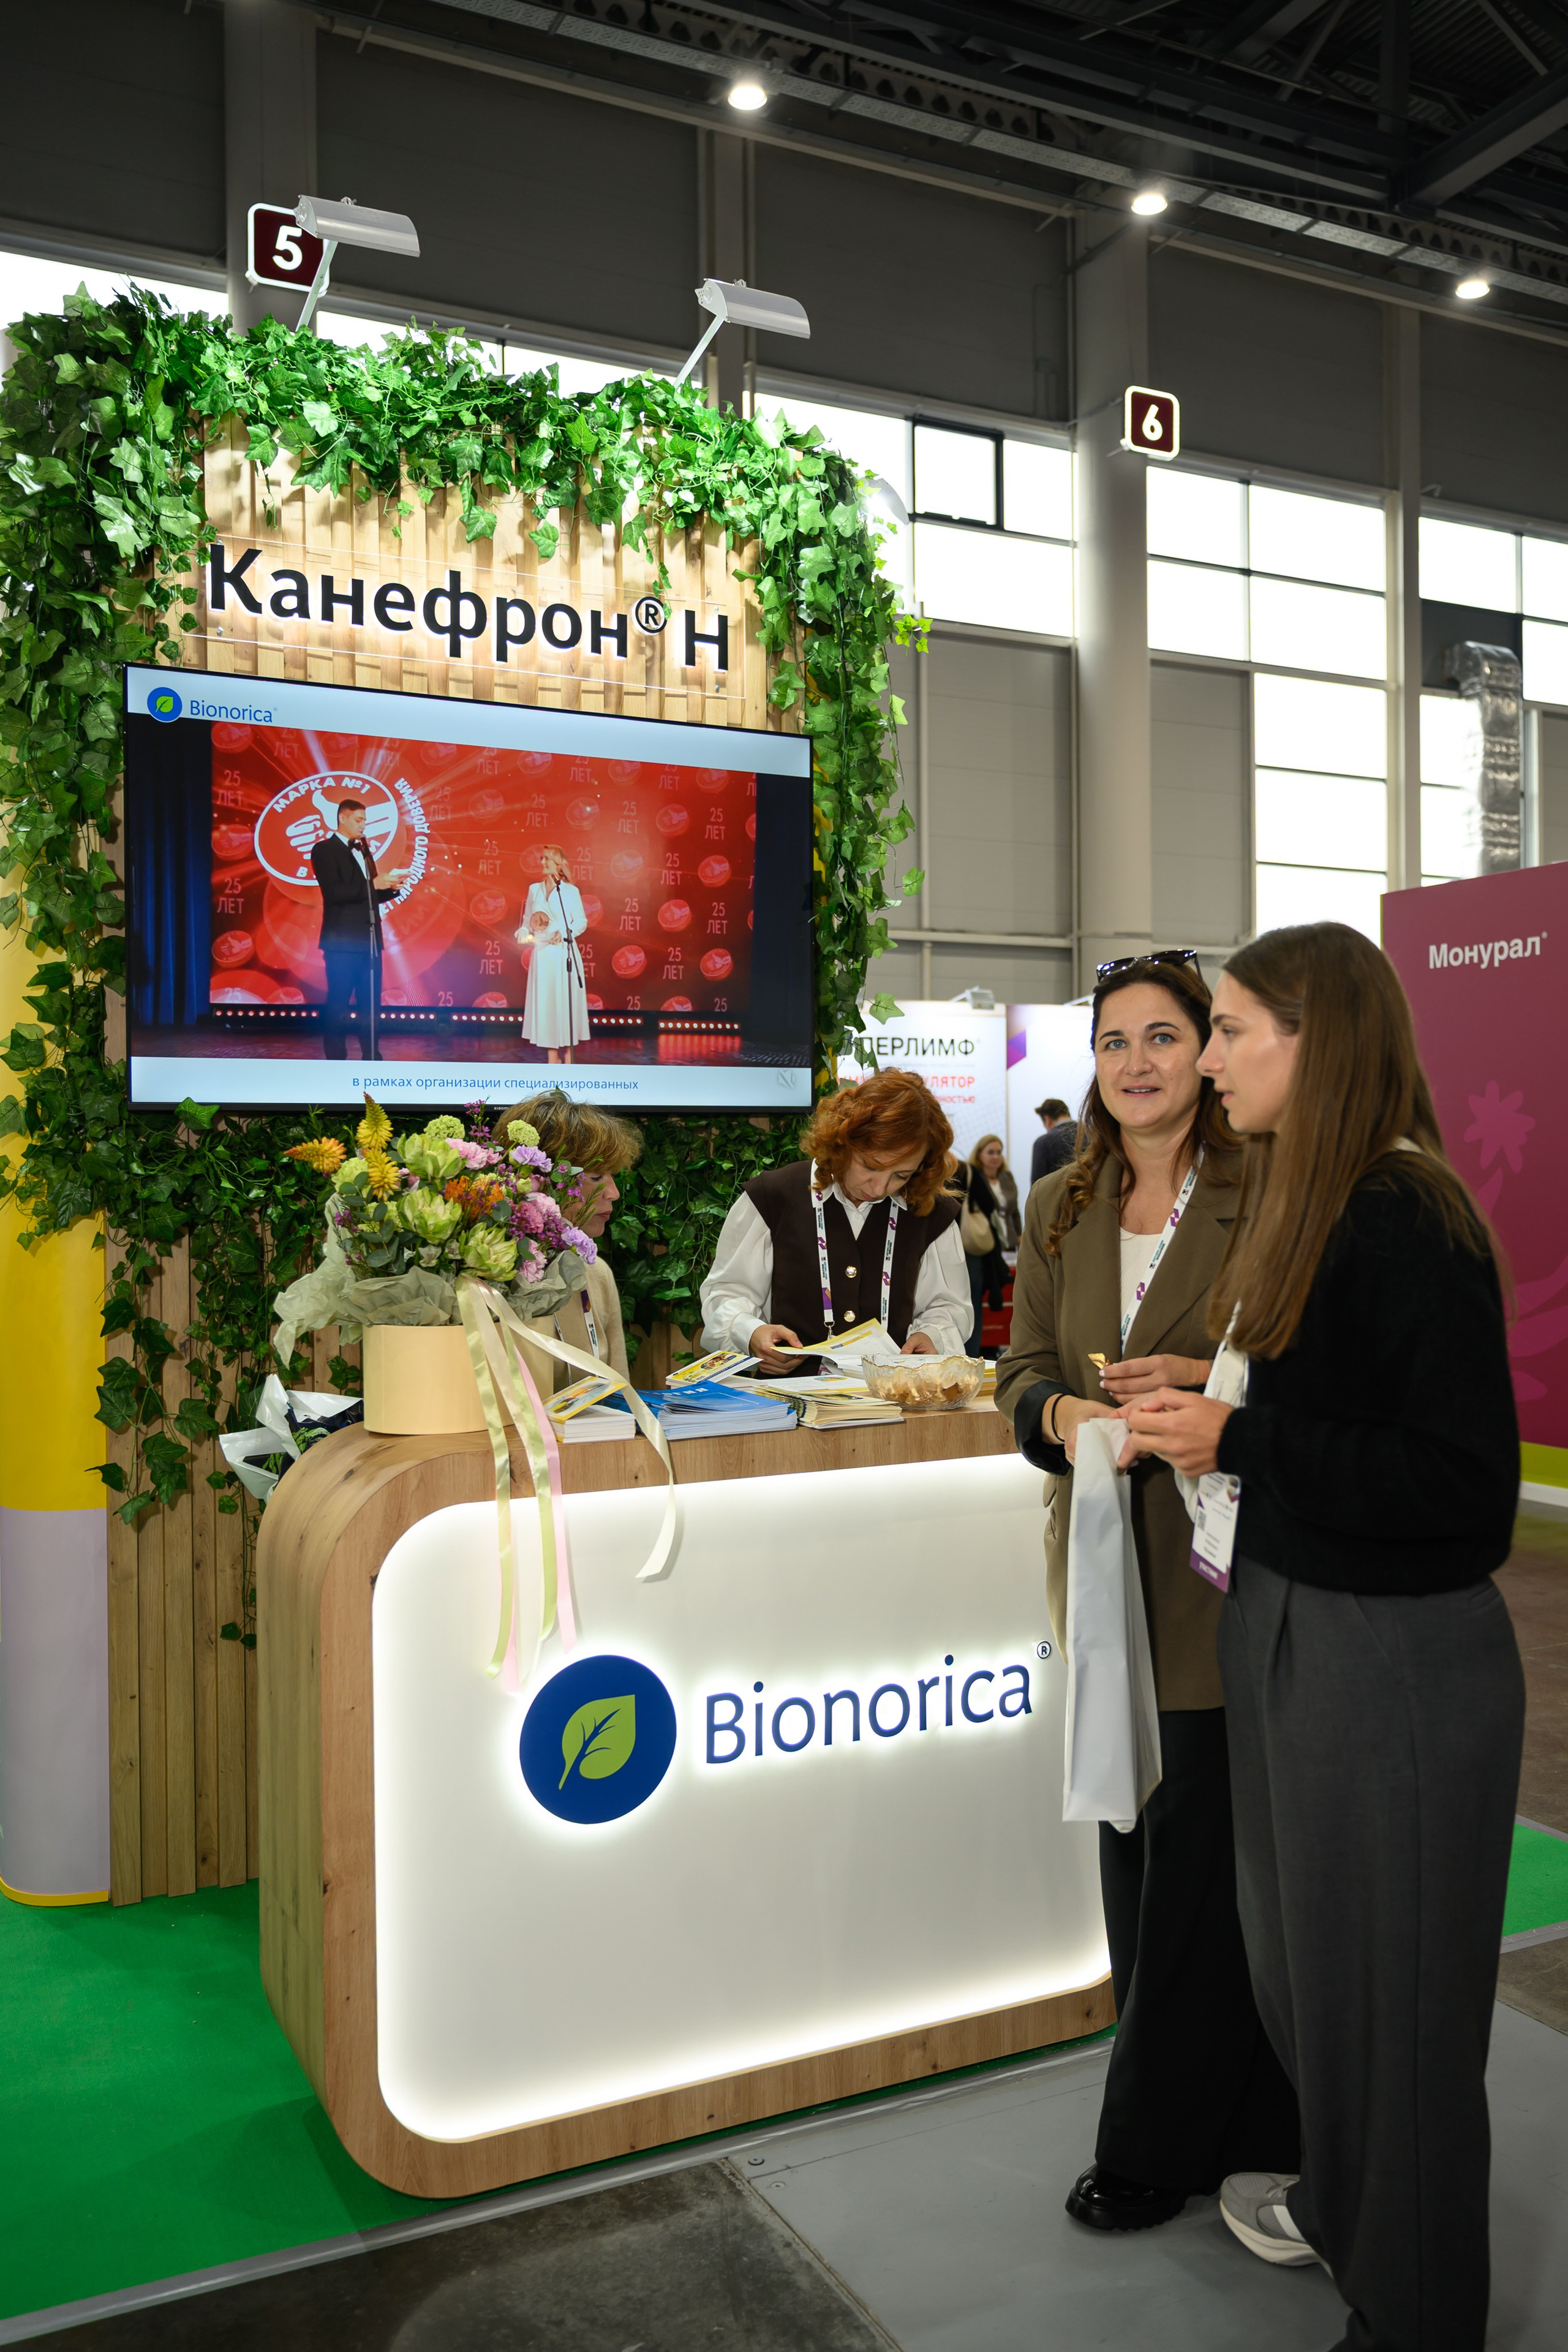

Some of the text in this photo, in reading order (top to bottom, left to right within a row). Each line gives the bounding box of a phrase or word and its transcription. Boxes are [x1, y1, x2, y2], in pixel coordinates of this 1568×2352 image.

[272, 225, 303, 271] 5
[1142, 404, 1163, 441] 6
[683, 609, 729, 671] Н
[274, 742, 300, 758] ЛЕТ
[477, 758, 499, 775] ЛЕТ
[224, 769, 241, 786] 25
[569, 767, 592, 783] ЛЕТ
[658, 775, 680, 790] ЛЕТ
[217, 790, 244, 806] ЛЕТ
[273, 777, 336, 813] МАРКА
[435, 786, 451, 802] 25
[531, 794, 546, 809] 25
[394, 777, 431, 834] ДОВЕРИЯ
[430, 805, 453, 821] ЛЕТ
[622, 801, 636, 816] 25
[526, 812, 549, 827] ЛЕТ
[710, 807, 723, 822] 25
[617, 818, 639, 834] ЛЕТ
[704, 825, 726, 840] ЛЕТ
[484, 841, 499, 856] 25
[576, 846, 591, 862] 25
[478, 859, 501, 875] ЛЕТ
[665, 853, 680, 867] 25
[296, 866, 308, 878] В
[573, 865, 594, 881] ЛЕТ
[660, 870, 682, 885] ЛЕТ
[224, 877, 241, 894] 25
[217, 897, 244, 914] ЛЕТ
[624, 897, 639, 913] 25
[712, 902, 726, 917] 25
[619, 916, 642, 931] ЛЕТ
[707, 920, 728, 934] ЛЕТ
[485, 941, 501, 956] 25
[579, 944, 594, 959] 25
[668, 948, 682, 962] 25
[480, 959, 503, 974] ЛЕТ
[582, 962, 596, 978] ЕТ
[663, 965, 684, 980] ЛЕТ
[224, 987, 242, 1003] 25
[438, 991, 453, 1007] 25
[627, 996, 641, 1011] 25
[714, 998, 728, 1012] 25
[859, 1037, 974, 1056] ПЕРЛИМФ
[352, 1077, 639, 1091] в рамках организации специализированных
